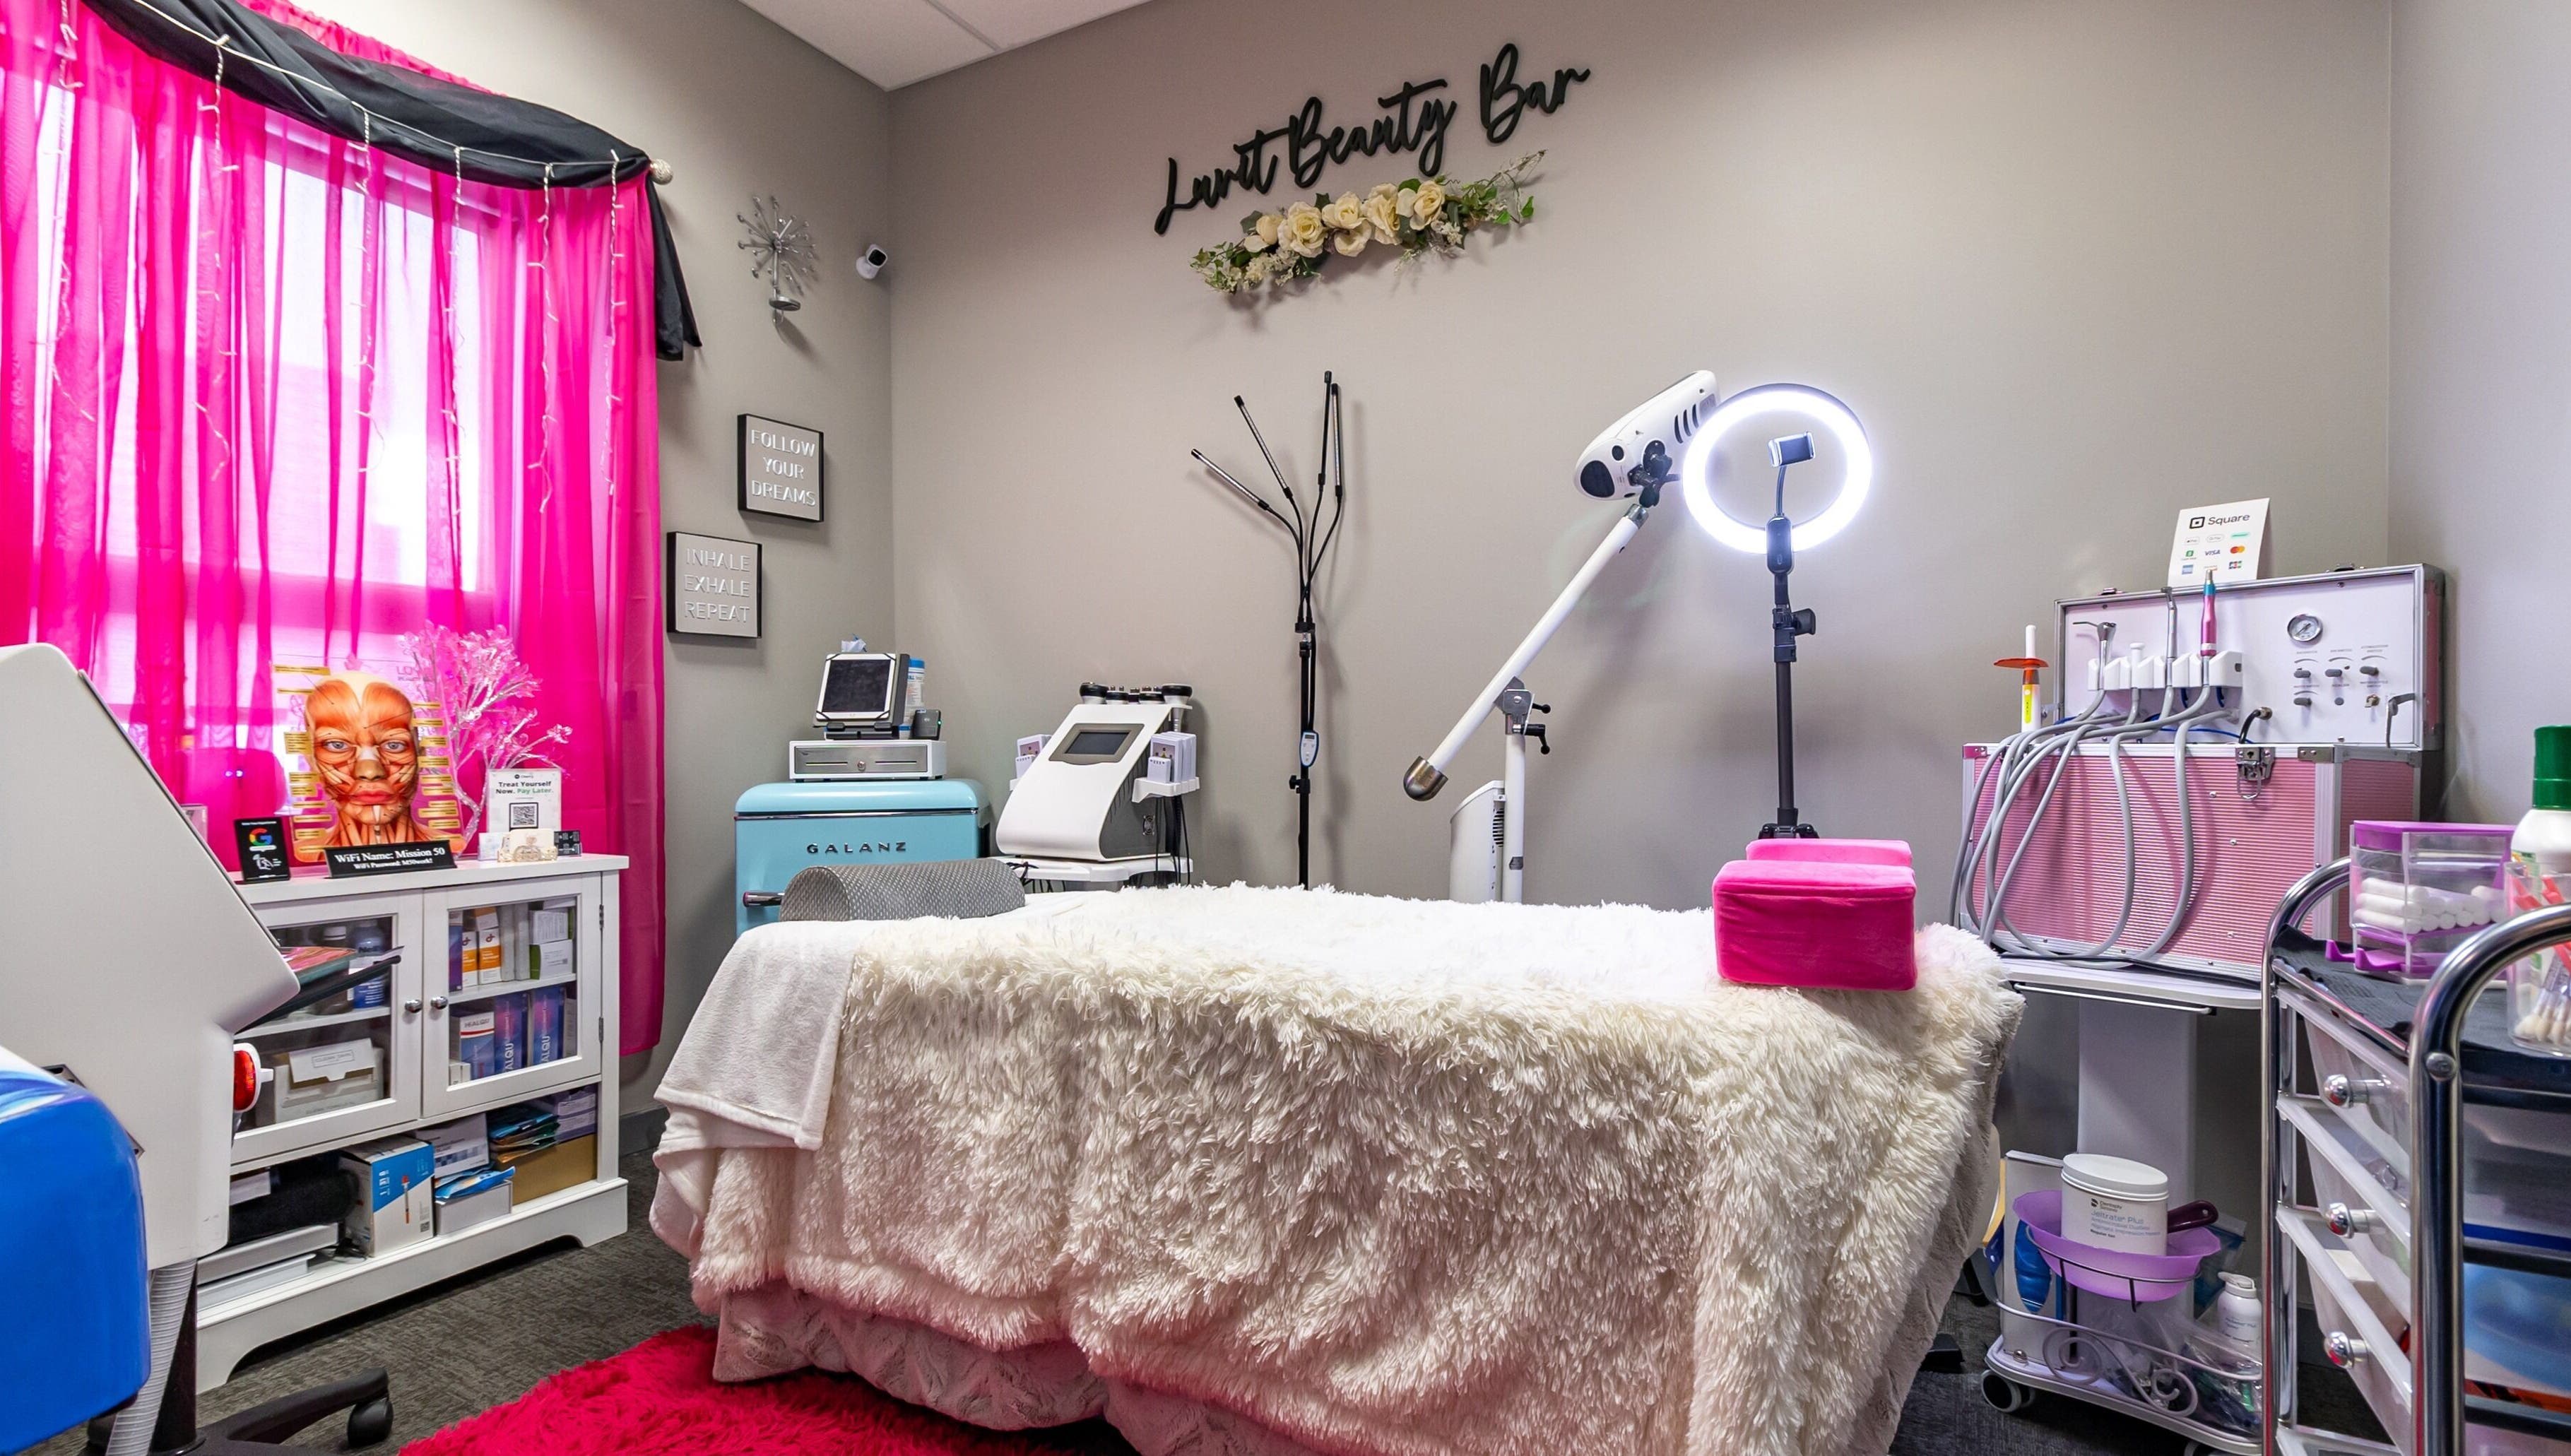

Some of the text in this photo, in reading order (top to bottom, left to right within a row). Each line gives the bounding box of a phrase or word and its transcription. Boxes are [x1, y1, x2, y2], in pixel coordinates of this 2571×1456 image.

[1289, 78, 1457, 188] Beauty
[1480, 43, 1590, 143] Bar
[751, 429, 816, 457] FOLLOW
[763, 456, 805, 479] YOUR
[751, 480, 816, 507] DREAMS
[2208, 514, 2250, 526] Square
[685, 548, 750, 572] INHALE
[684, 574, 750, 597] EXHALE
[685, 600, 750, 622] REPEAT
[334, 847, 446, 863] WiFi Name: Mission 50
[806, 841, 906, 854] GALANZ
[504, 1043, 514, 1073] ALQU
[541, 1036, 551, 1063] ALQU
